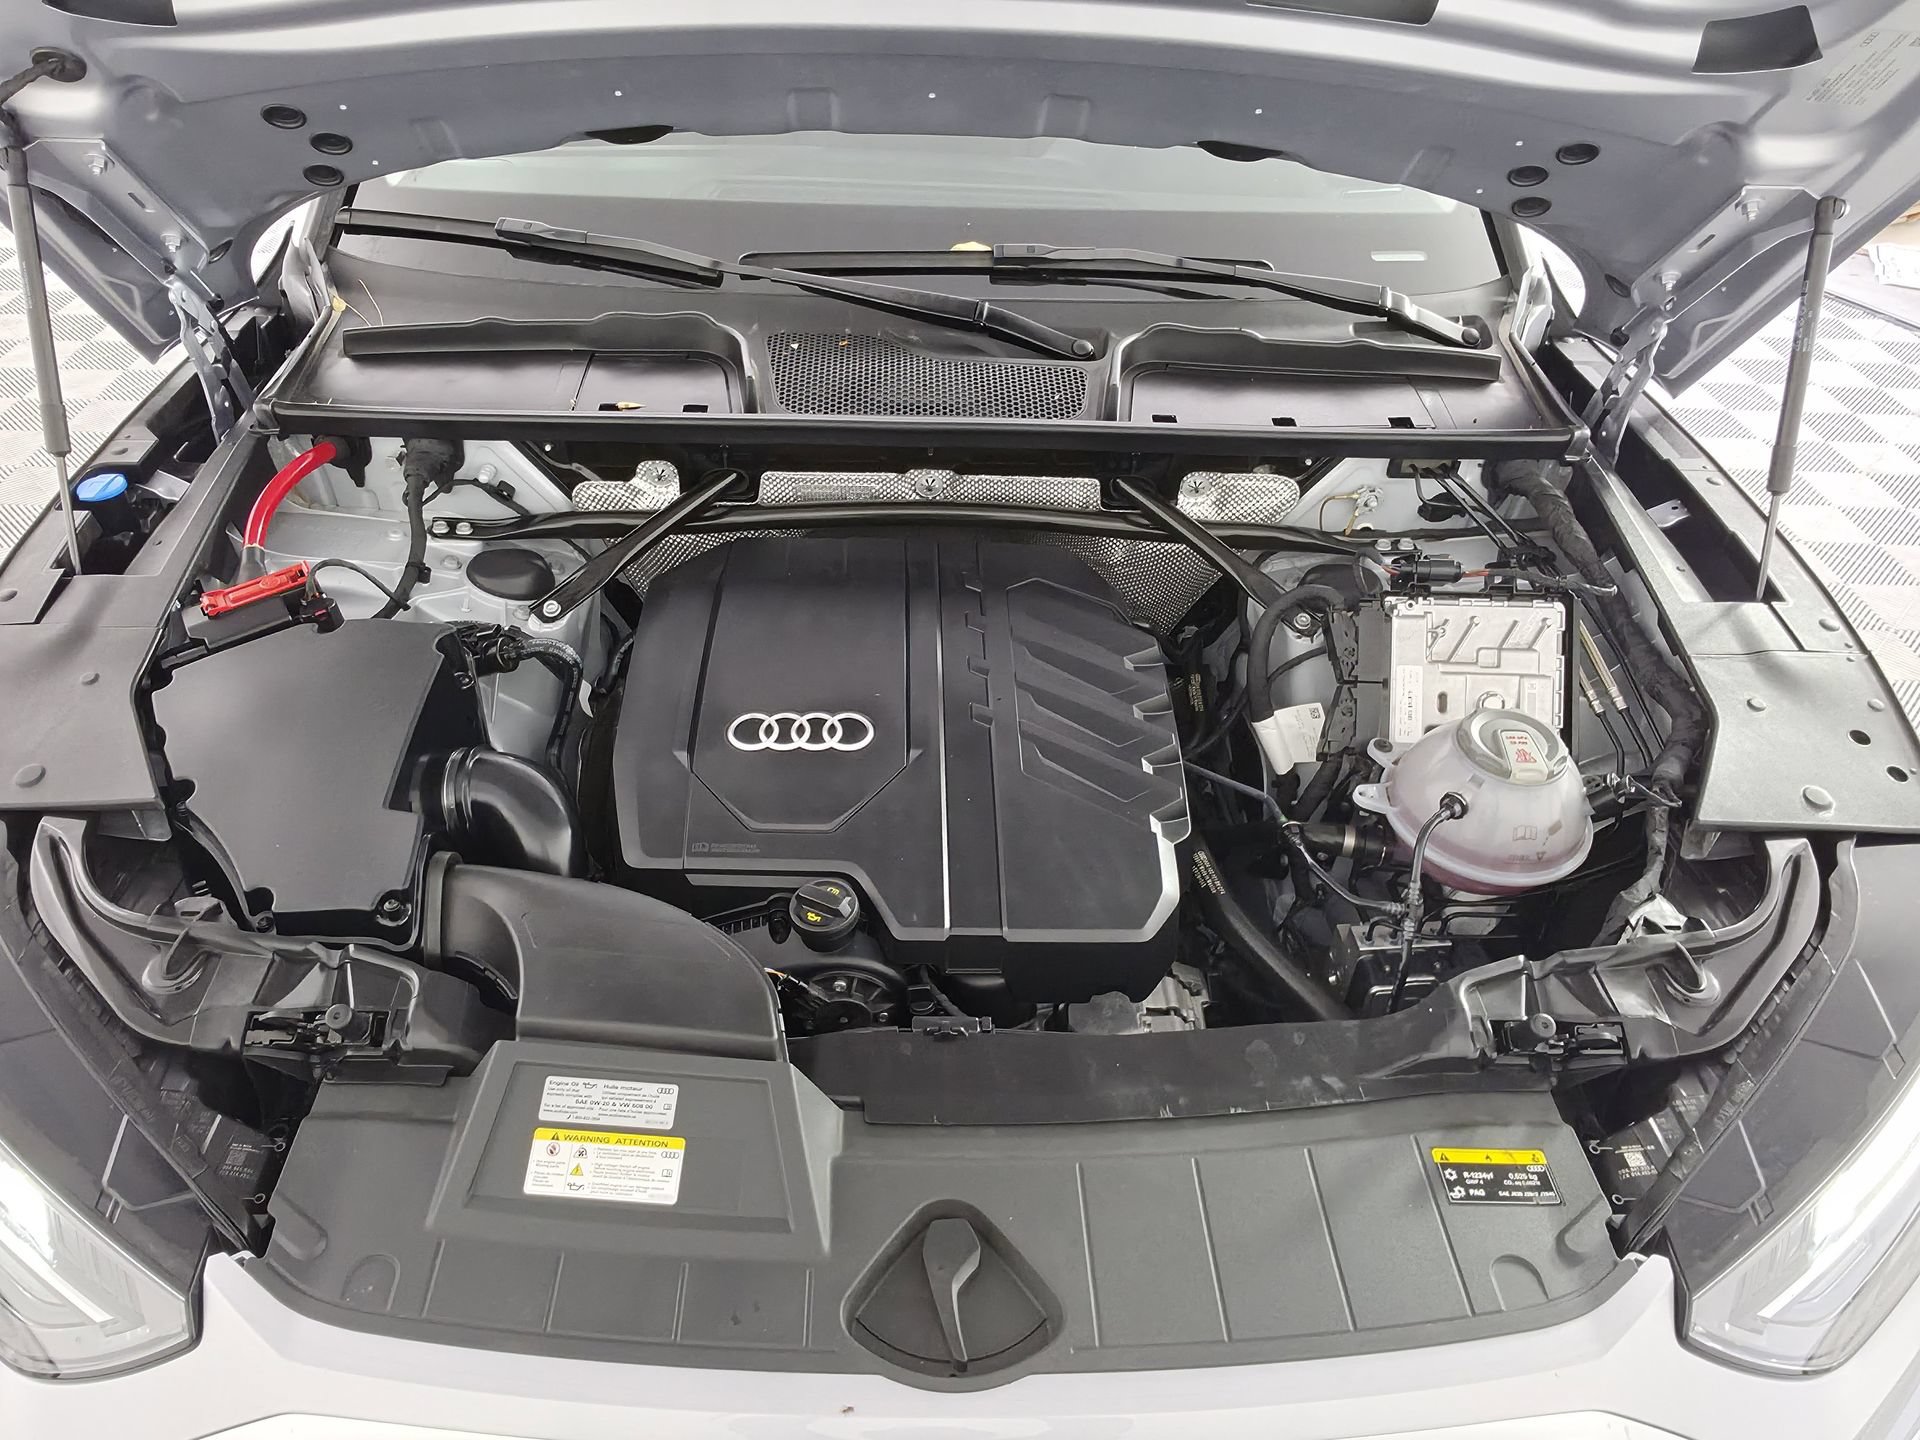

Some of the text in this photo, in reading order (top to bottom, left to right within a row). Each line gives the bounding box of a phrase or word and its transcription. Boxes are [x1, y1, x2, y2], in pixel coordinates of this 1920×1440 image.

[564, 1134, 669, 1148] WARNING ATTENTION
[1468, 1188, 1486, 1197] PAG
